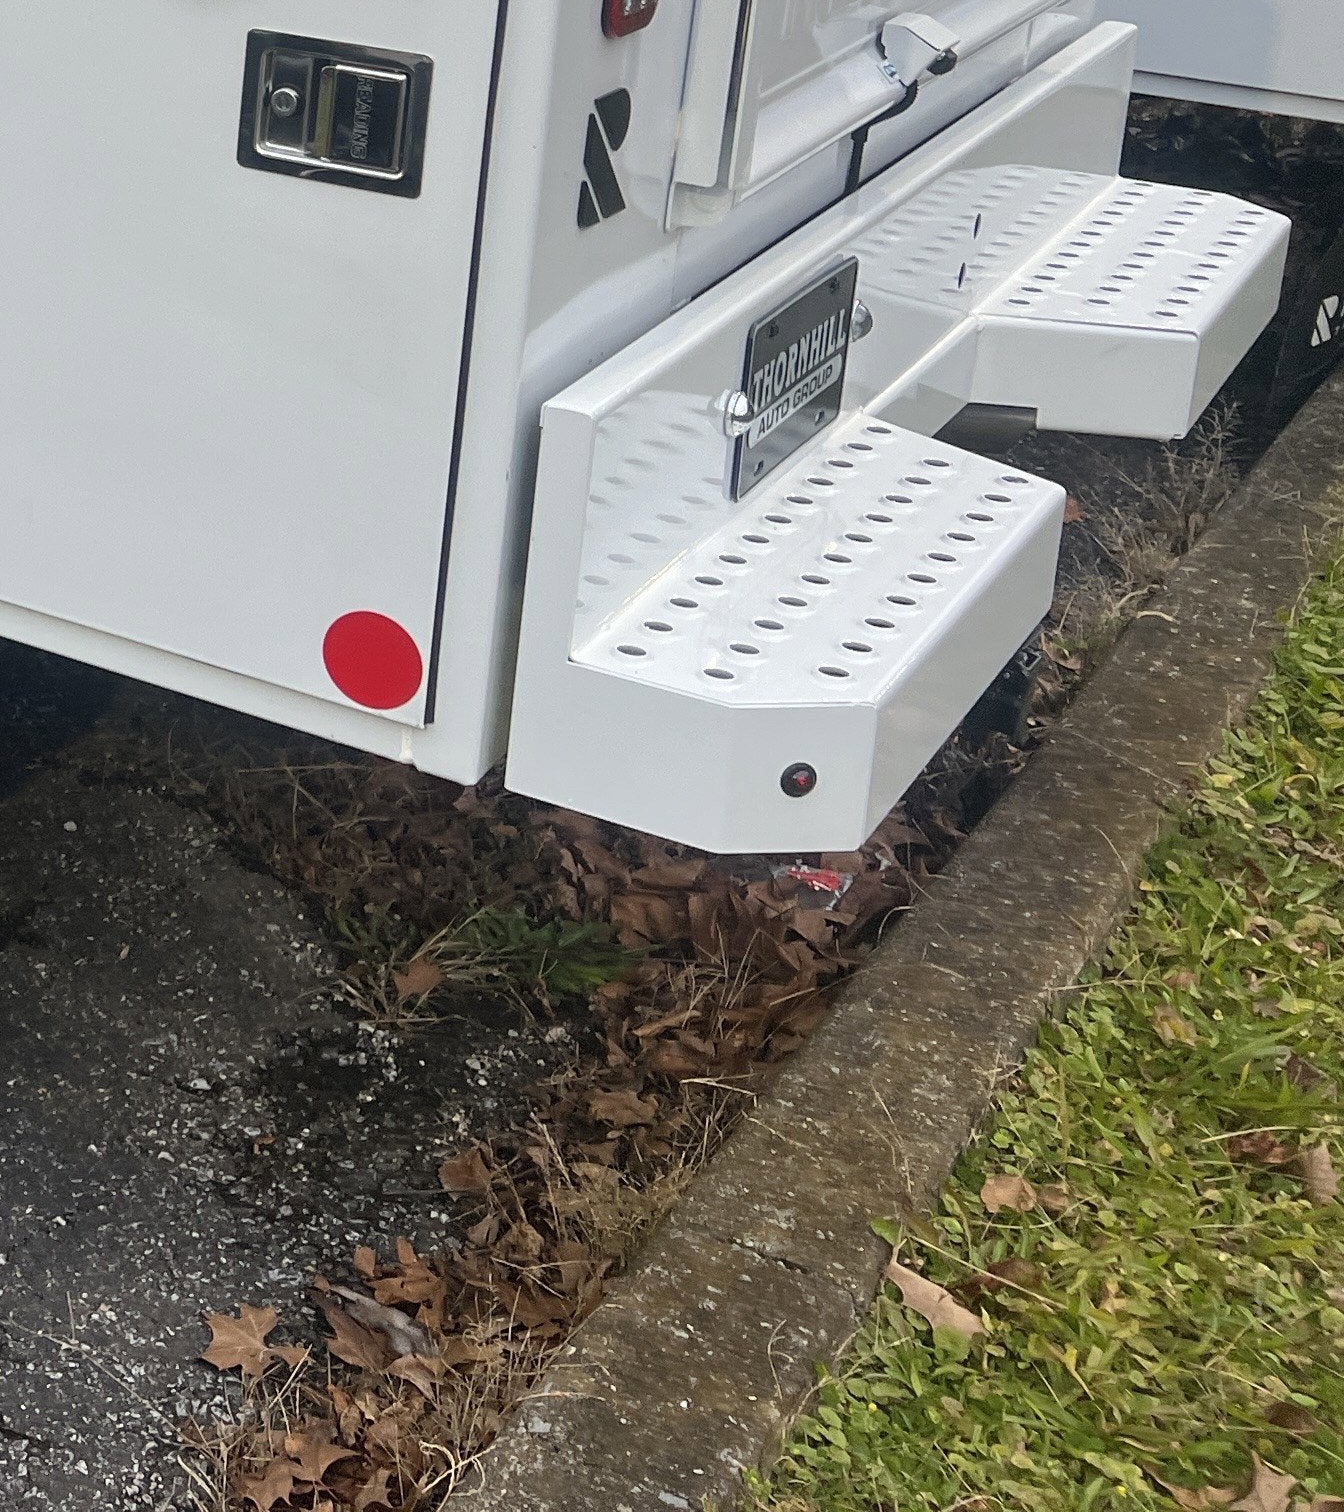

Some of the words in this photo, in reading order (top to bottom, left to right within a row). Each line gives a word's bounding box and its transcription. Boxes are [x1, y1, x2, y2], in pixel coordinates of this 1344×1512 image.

[751, 308, 849, 414] THORNHILL
[758, 397, 789, 435] AUTO
[792, 363, 833, 410] GROUP
